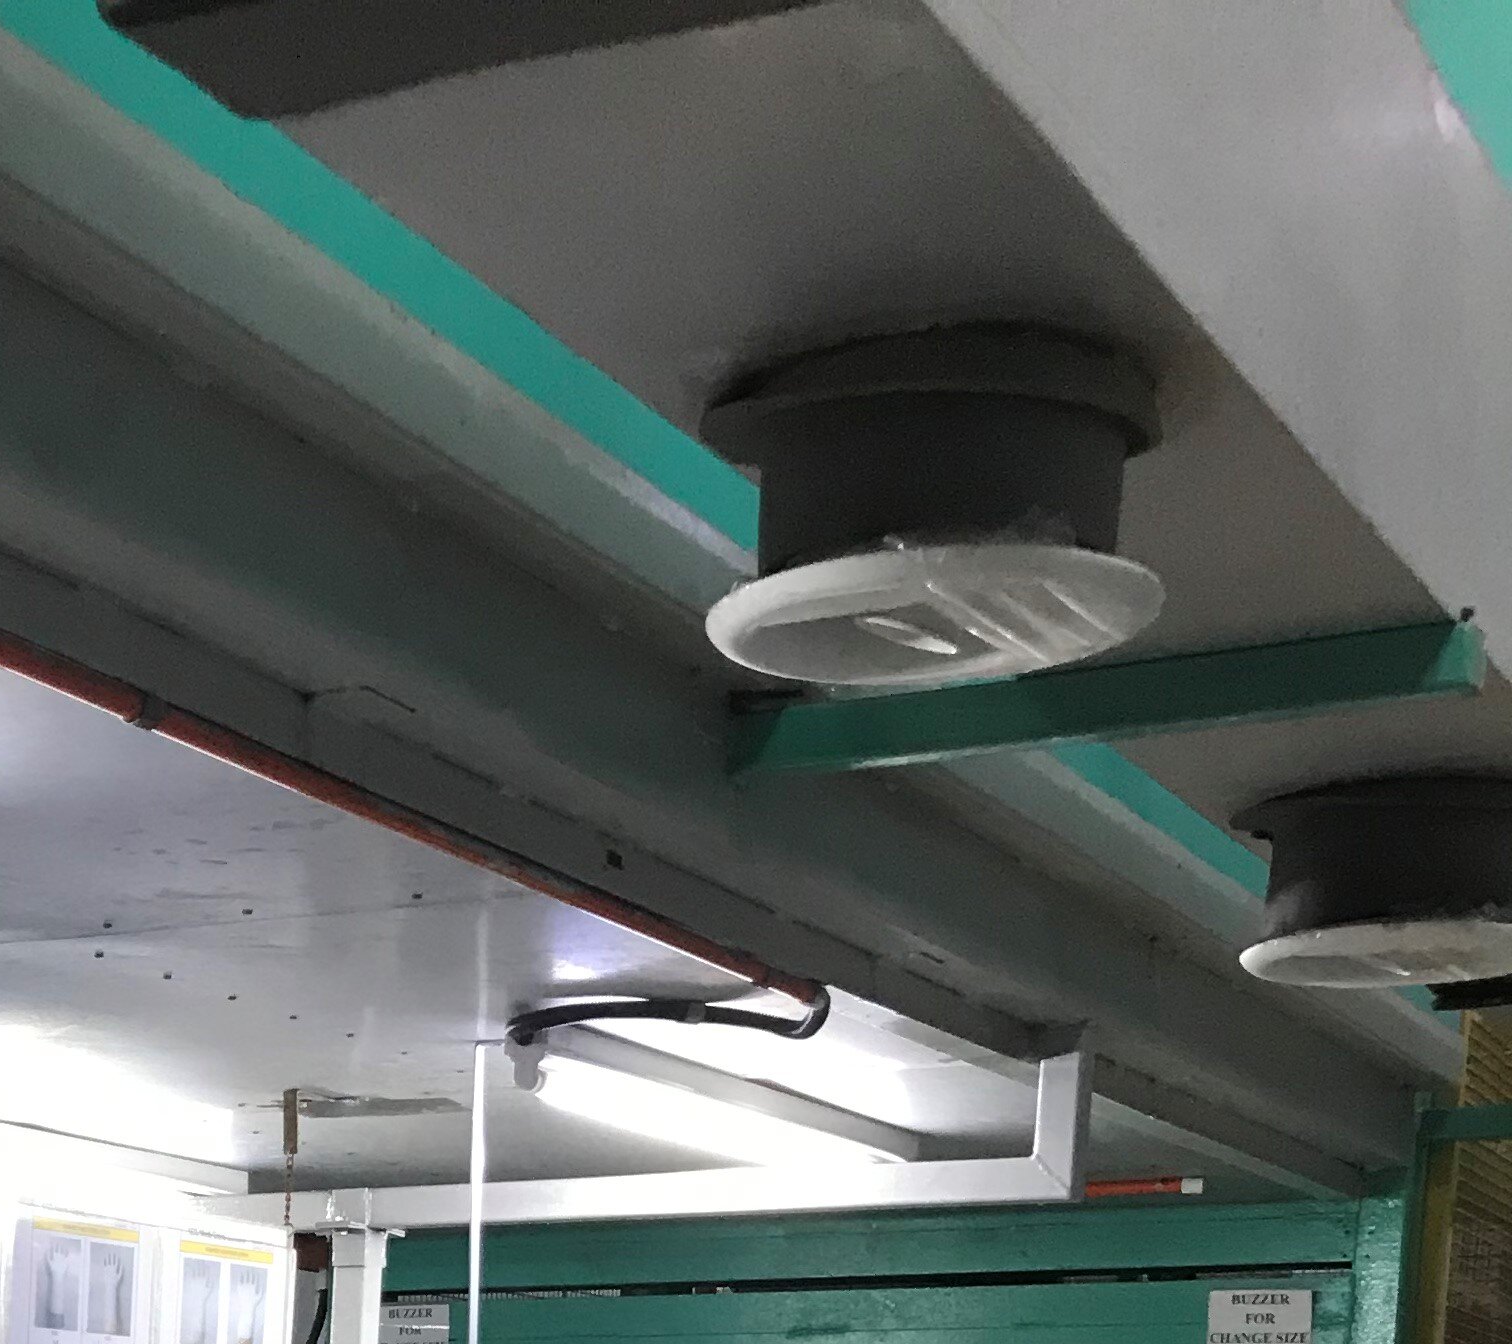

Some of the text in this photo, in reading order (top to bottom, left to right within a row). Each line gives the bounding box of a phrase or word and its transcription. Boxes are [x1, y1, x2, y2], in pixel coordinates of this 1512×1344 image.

[1231, 1294, 1290, 1305] BUZZER
[388, 1308, 433, 1318] BUZZER
[1245, 1313, 1276, 1324] FOR
[1209, 1332, 1308, 1343] CHANGE SIZE
